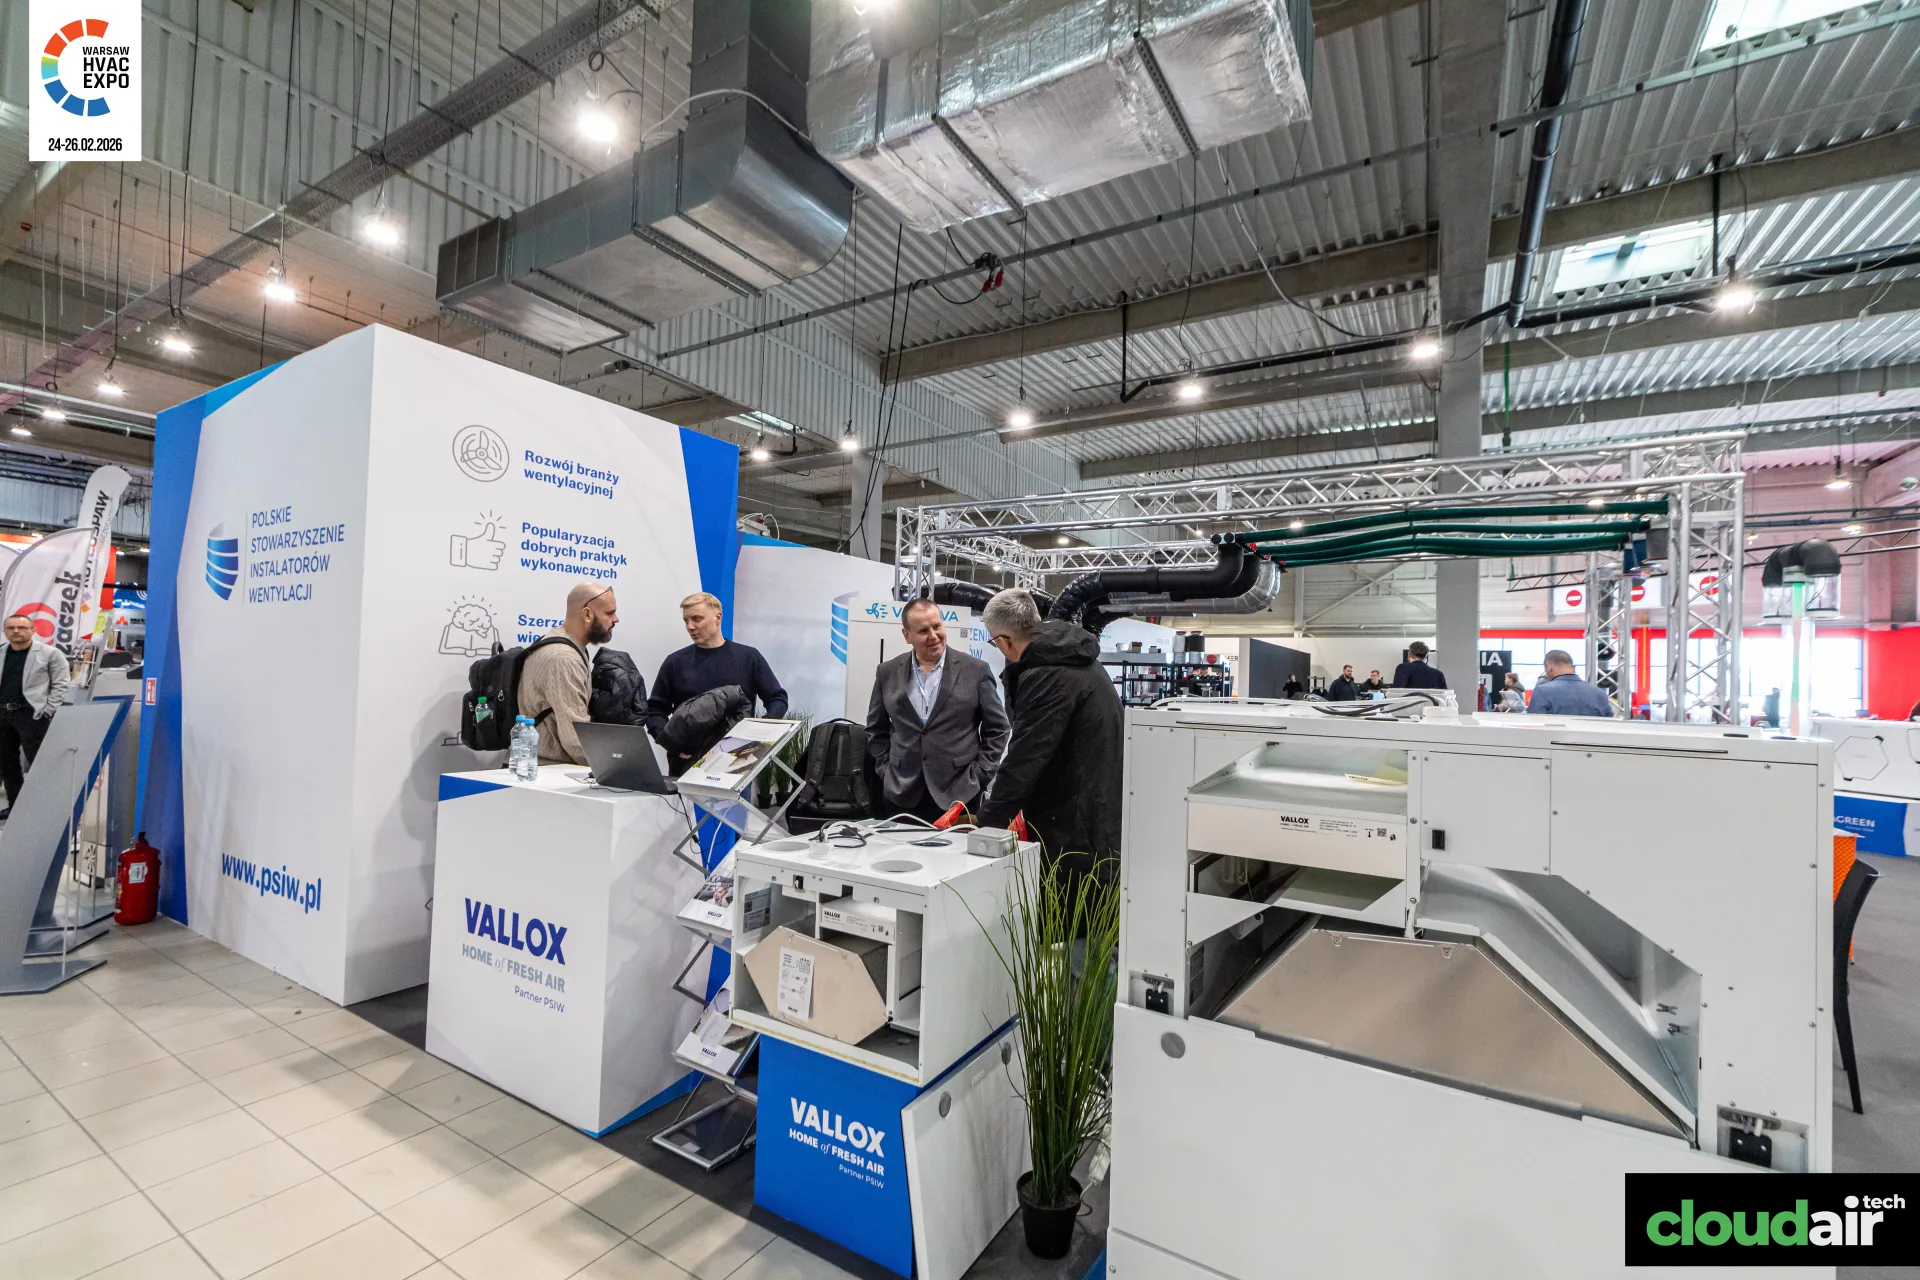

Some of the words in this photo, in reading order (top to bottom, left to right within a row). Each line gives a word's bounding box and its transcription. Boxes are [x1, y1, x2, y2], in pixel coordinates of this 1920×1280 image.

[524, 449, 574, 471] Rozwój
[576, 462, 620, 485] branży
[523, 466, 614, 499] wentylacyjnej
[252, 505, 292, 529] POLSKIE
[251, 523, 345, 554] STOWARZYSZENIE
[521, 521, 615, 549] Popularyzacja
[250, 550, 331, 578] INSTALATORÓW
[520, 538, 577, 558] dobrych
[579, 549, 628, 566] praktyk
[520, 557, 618, 580] wykonawczych
[248, 583, 313, 603] WENTYLACJI
[1280, 815, 1310, 825] VALLOX
[1834, 815, 1876, 828] GREEN
[222, 852, 322, 915] www.psiw.pl
[823, 910, 841, 919] VALLOX
[464, 897, 568, 966] VALLOX
[461, 943, 493, 966] HOME
[495, 957, 507, 973] of
[507, 959, 543, 985] FRESH
[545, 973, 566, 993] AIR
[514, 985, 543, 1004] Partner
[543, 996, 565, 1013] PSIW
[790, 1096, 886, 1158] VALLOX
[789, 1128, 819, 1148] HOME
[820, 1143, 831, 1155] of
[831, 1145, 865, 1168] FRESH
[866, 1160, 885, 1177] AIR
[839, 1164, 864, 1180] Partner
[865, 1175, 885, 1189] PSIW
